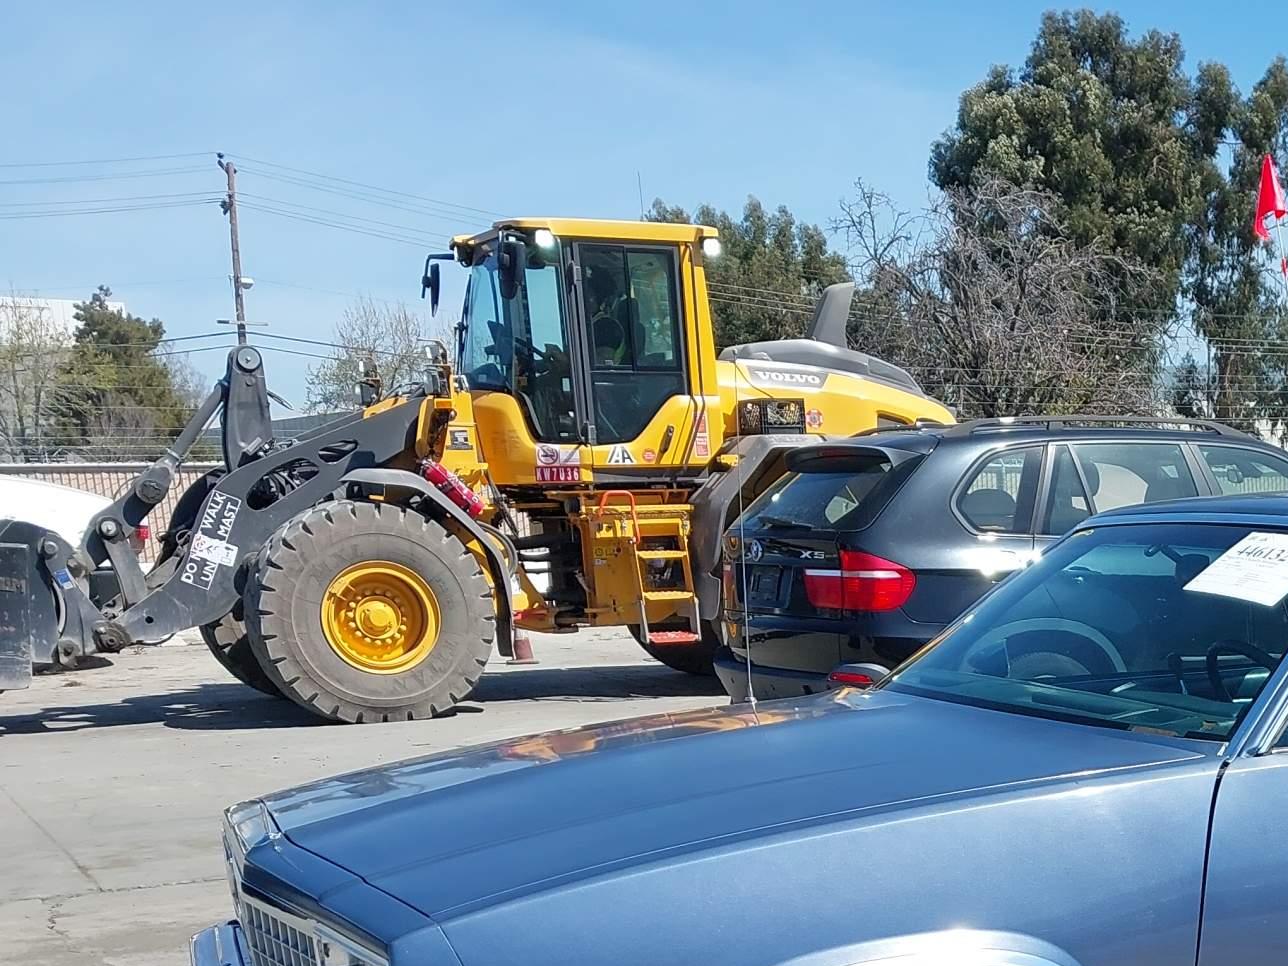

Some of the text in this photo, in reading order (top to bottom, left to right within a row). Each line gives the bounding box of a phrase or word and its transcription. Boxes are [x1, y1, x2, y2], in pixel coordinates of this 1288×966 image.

[755, 370, 821, 384] VOLVO
[216, 501, 238, 538] MAST
[181, 492, 227, 584] DO WALK
[800, 550, 825, 559] X5
